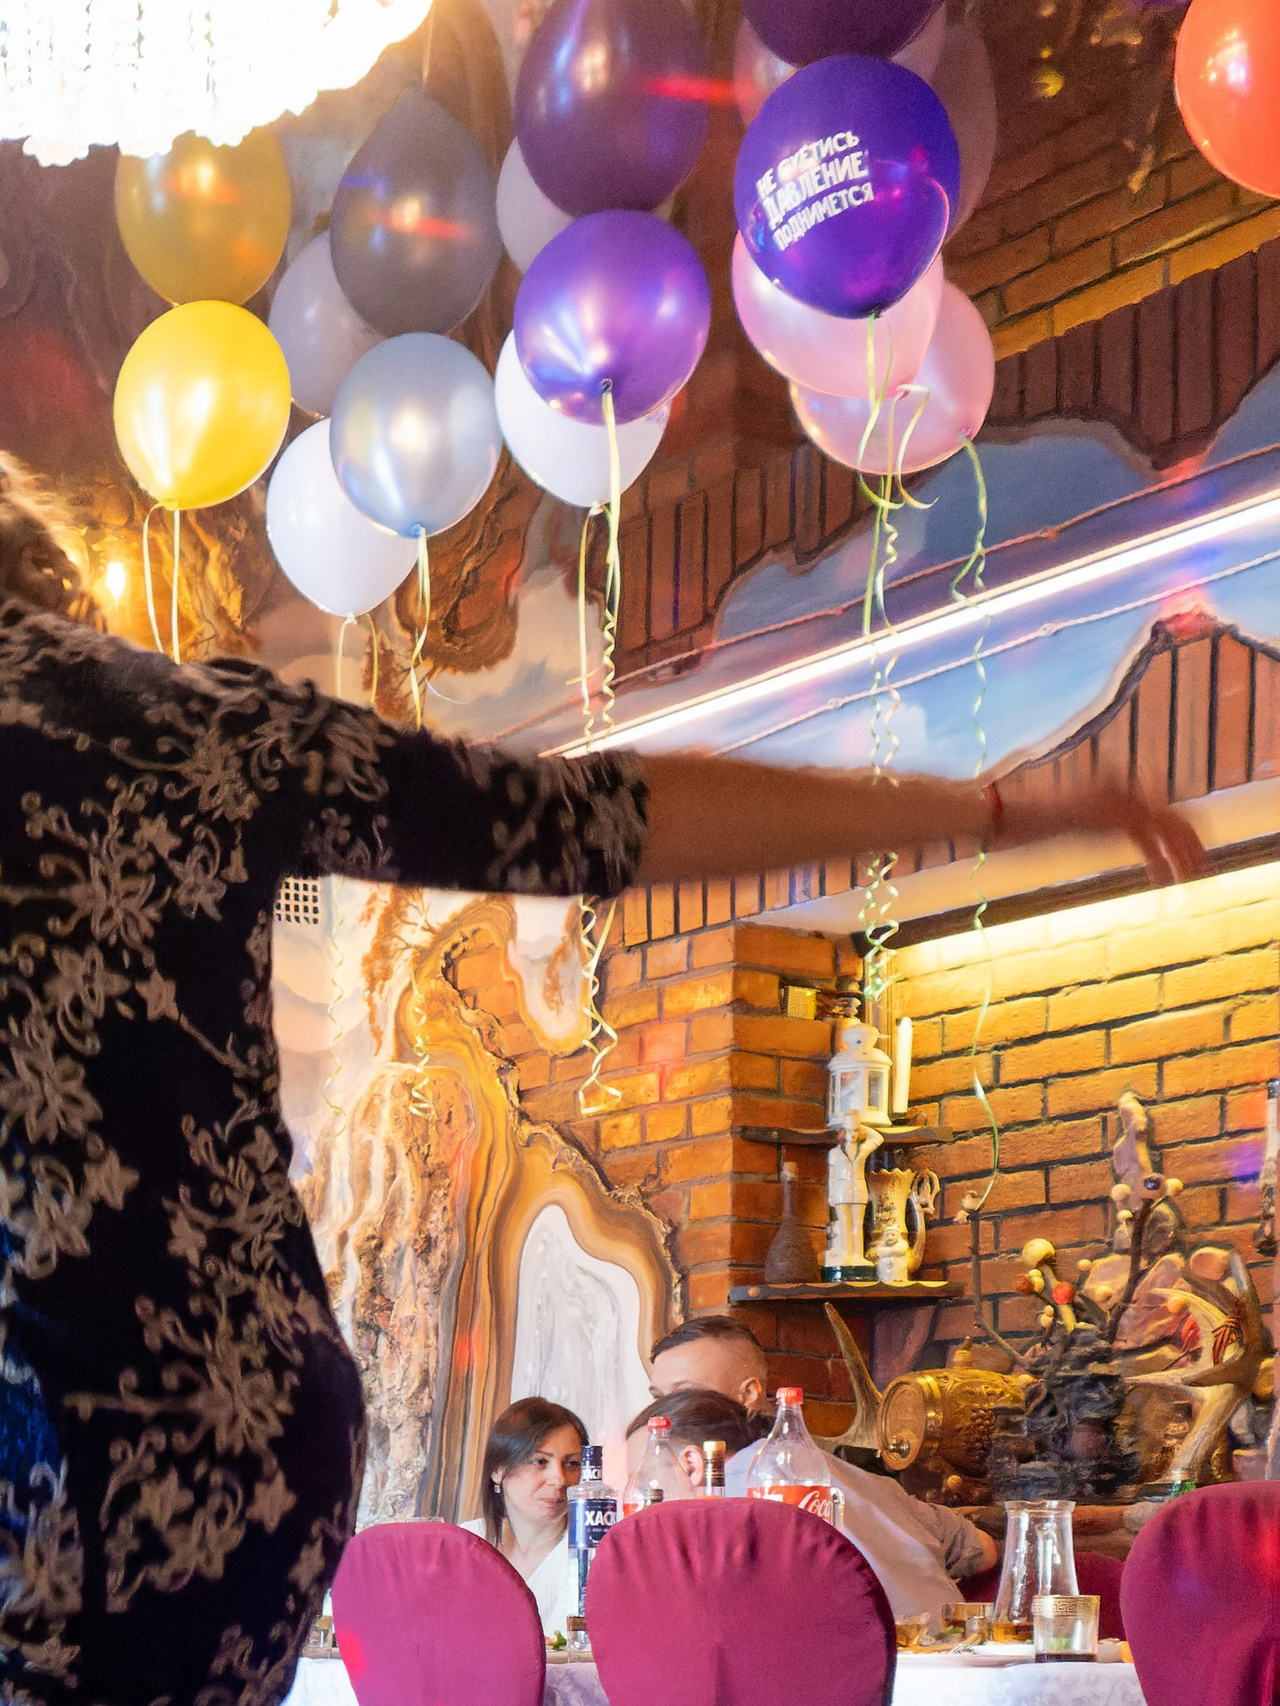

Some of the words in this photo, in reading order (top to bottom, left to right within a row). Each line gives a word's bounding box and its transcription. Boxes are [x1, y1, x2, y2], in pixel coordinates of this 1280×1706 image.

[756, 168, 777, 200] НЕ
[777, 131, 860, 180] СУЕТИСЬ
[762, 150, 869, 231] ДАВЛЕНИЕ
[773, 182, 875, 251] ПОДНИМЕТСЯ
